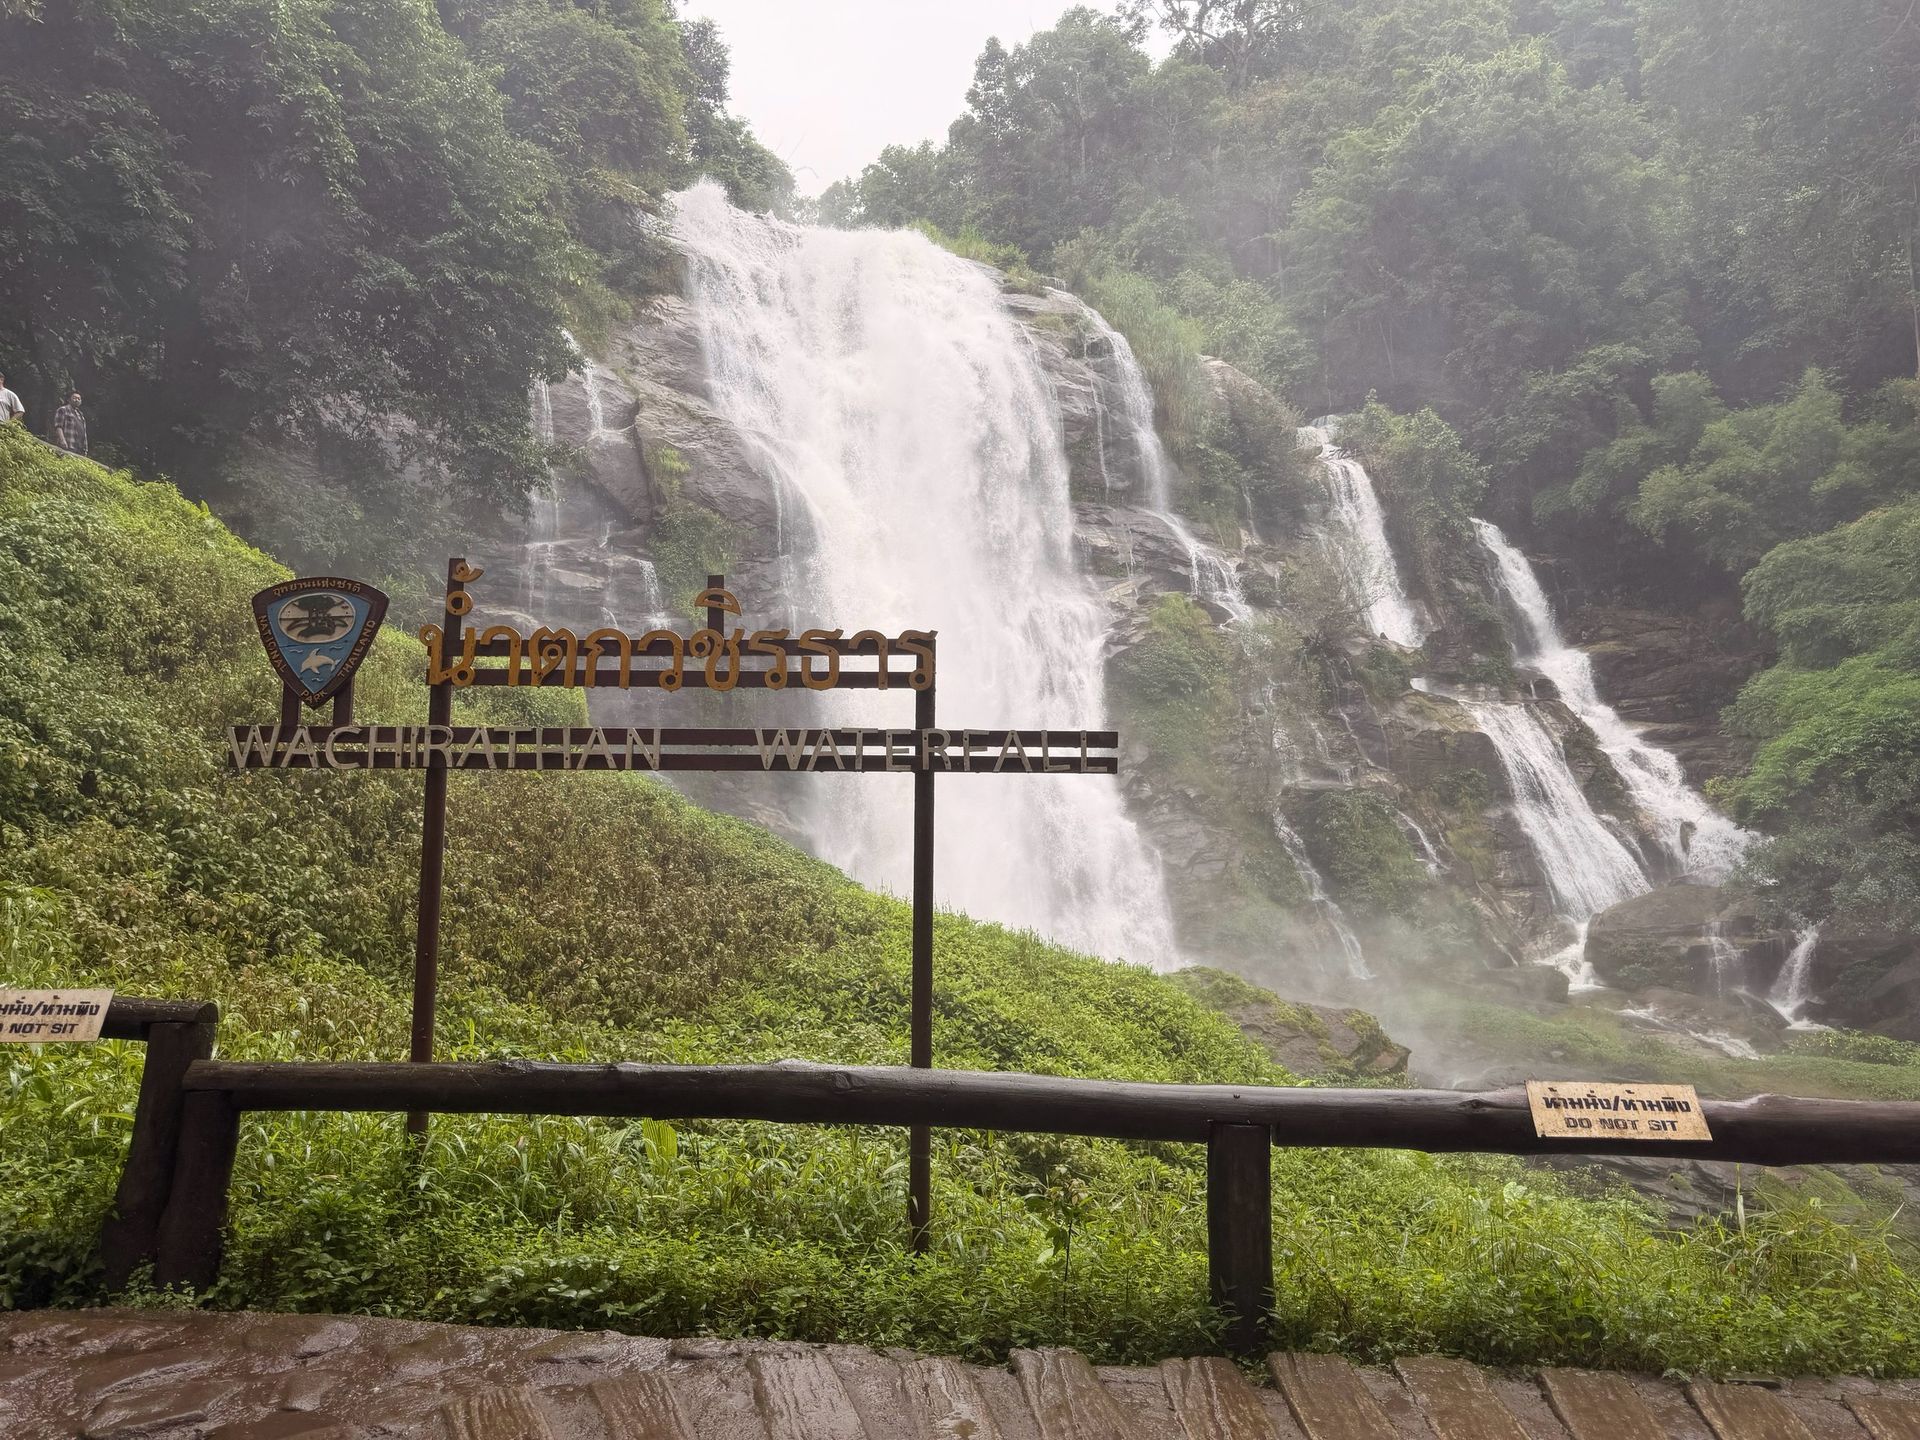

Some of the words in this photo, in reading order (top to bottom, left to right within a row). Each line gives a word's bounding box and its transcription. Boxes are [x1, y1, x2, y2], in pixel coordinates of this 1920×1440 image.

[258, 615, 288, 673] NATIONAL
[337, 619, 376, 678] THAILAND
[418, 561, 938, 691] น้ำตกวชิรธาร
[300, 689, 328, 704] PARK
[227, 724, 662, 770] WACHIRATHAN
[754, 727, 1108, 772] WATERFALL
[9, 1023, 48, 1034] NOT
[50, 1023, 79, 1034] SIT
[1564, 1117, 1593, 1129] DO
[1599, 1117, 1639, 1131] NOT
[1648, 1119, 1679, 1132] SIT
